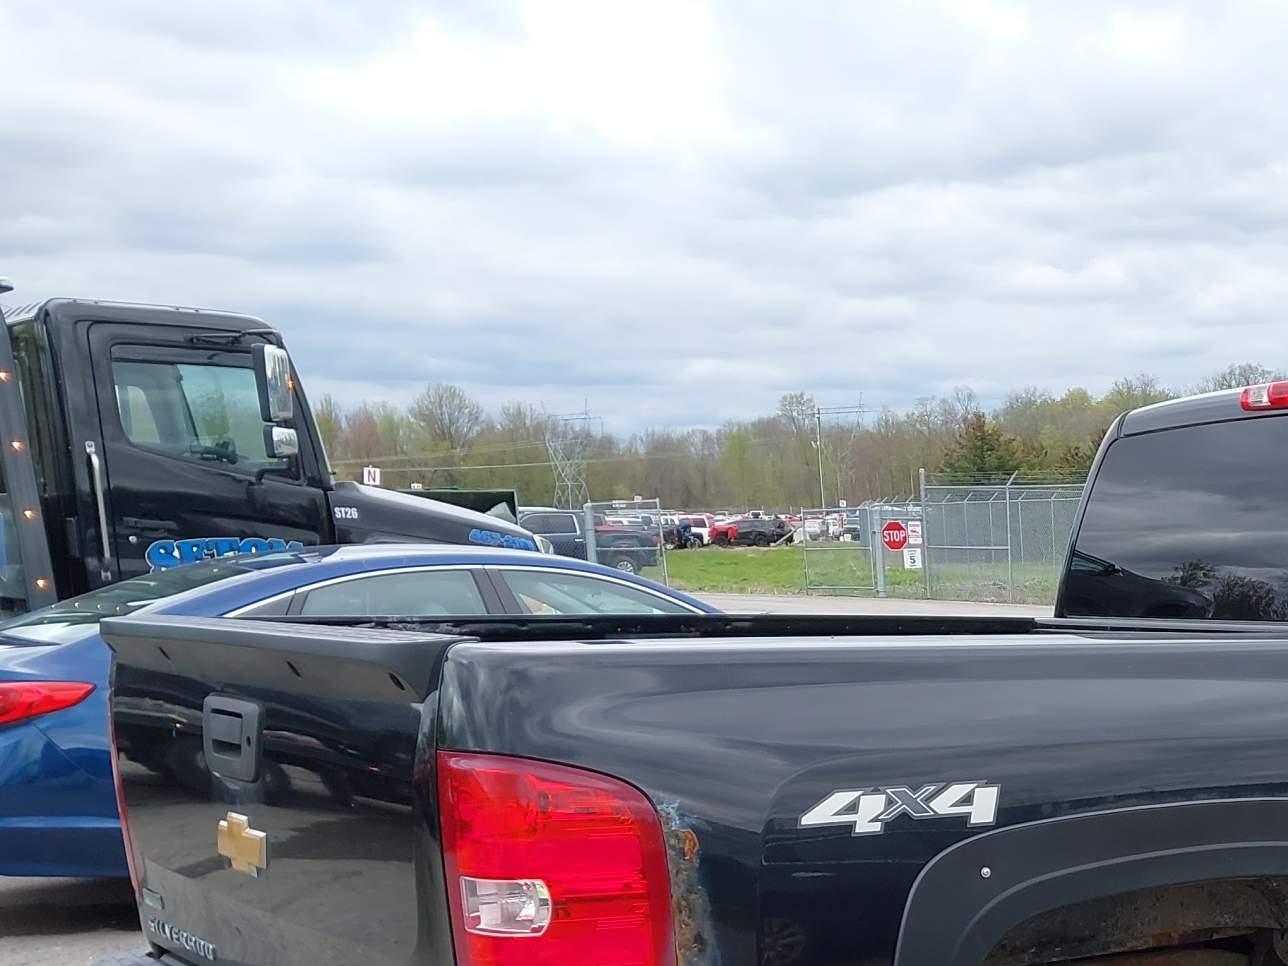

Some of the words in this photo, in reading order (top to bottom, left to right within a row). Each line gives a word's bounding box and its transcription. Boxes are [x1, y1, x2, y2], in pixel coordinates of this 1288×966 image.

[367, 469, 376, 483] N
[334, 506, 358, 519] ST26
[883, 530, 906, 542] STOP
[909, 556, 916, 564] 5
